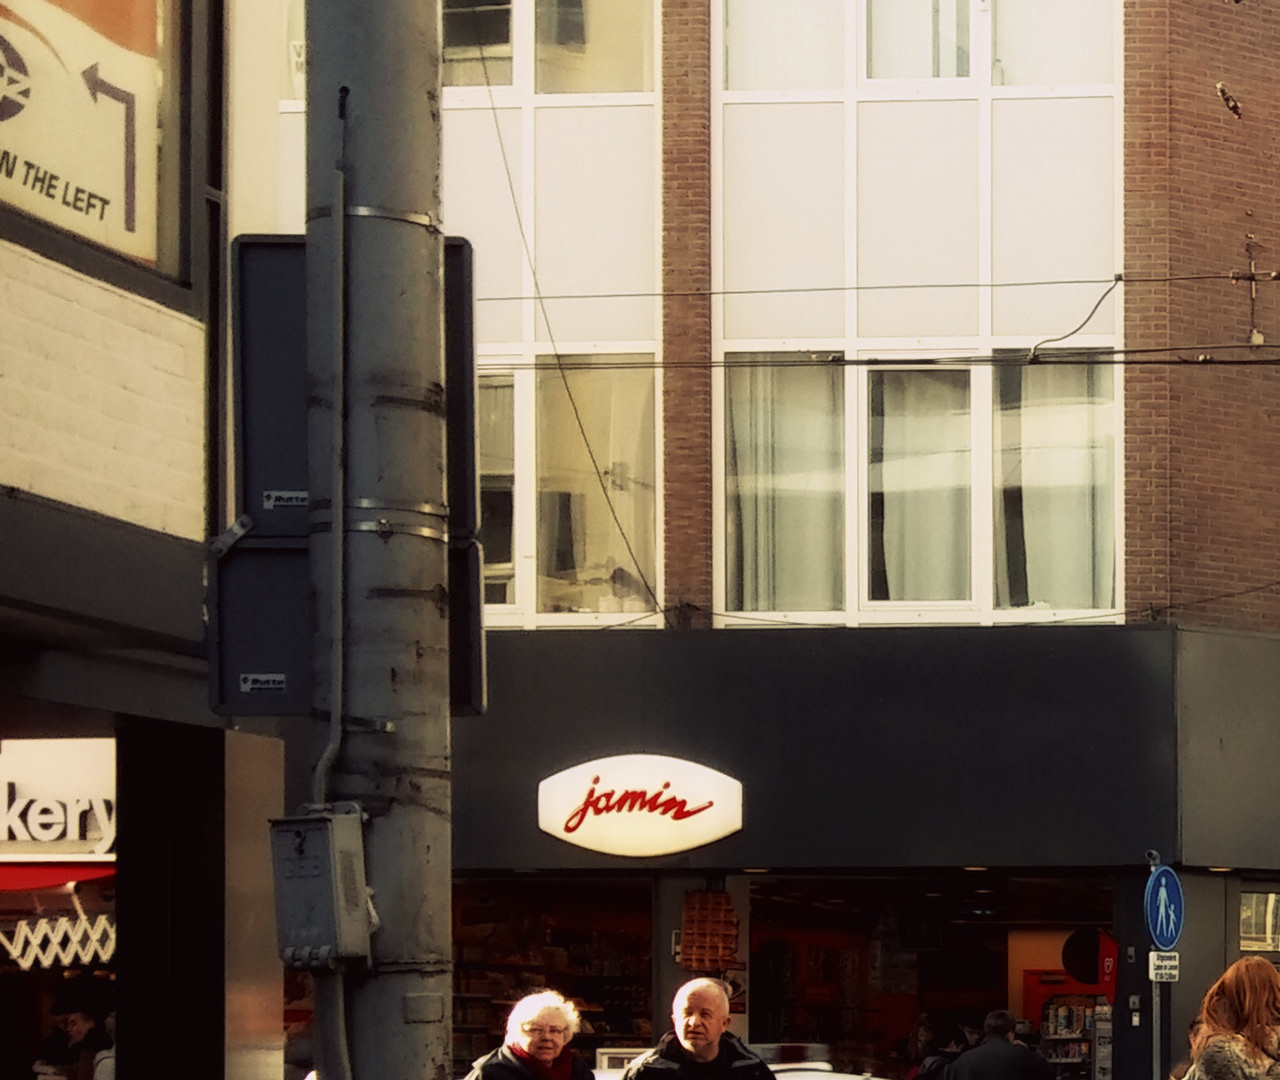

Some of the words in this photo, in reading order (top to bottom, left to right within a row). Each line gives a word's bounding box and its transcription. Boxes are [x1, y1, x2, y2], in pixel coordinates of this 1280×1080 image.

[22, 160, 60, 199] THE
[61, 181, 111, 221] LEFT
[563, 774, 714, 833] jamin
